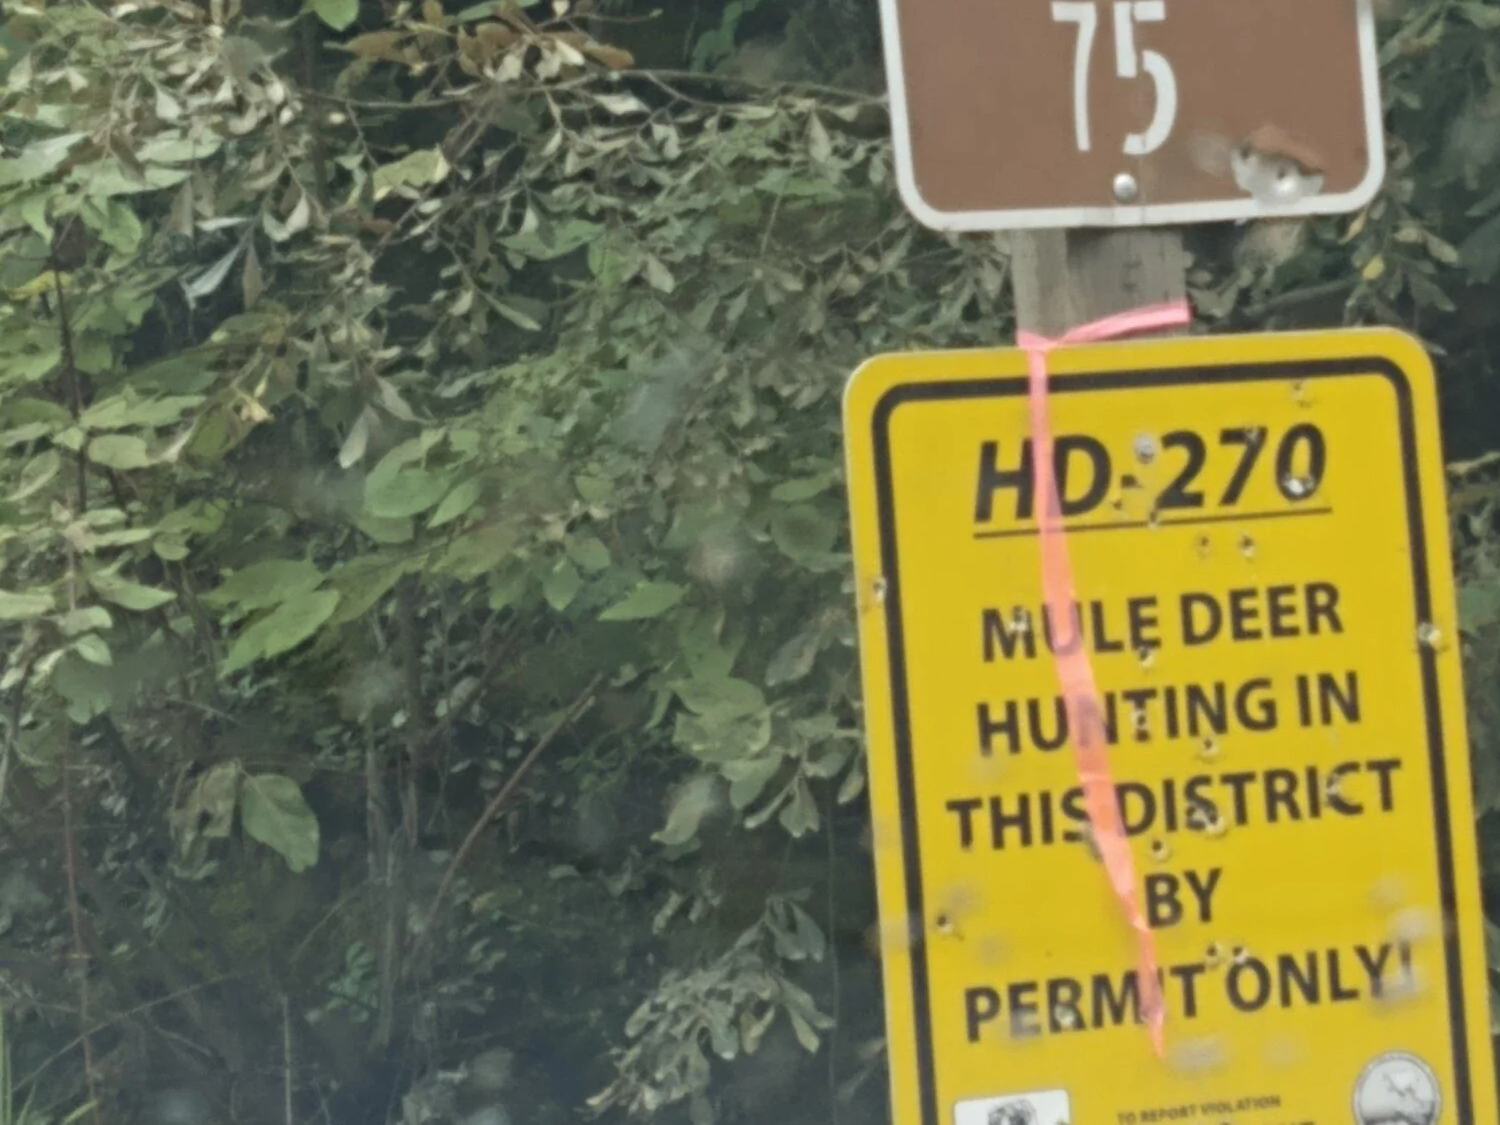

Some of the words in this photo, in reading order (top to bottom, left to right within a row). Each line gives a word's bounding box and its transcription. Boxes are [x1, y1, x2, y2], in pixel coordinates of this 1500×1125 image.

[1051, 0, 1177, 155] 75
[1156, 422, 1327, 512] 270
[981, 595, 1161, 663] MULE
[1179, 581, 1343, 647] DEER
[976, 677, 1278, 757] HUNTING
[1296, 670, 1361, 727] IN
[946, 785, 1093, 850] THIS
[1112, 758, 1402, 837] DISTRICT
[1144, 867, 1222, 929] BY
[964, 962, 1206, 1043] PERMIT
[1117, 1112, 1136, 1124] TO
[1140, 1104, 1197, 1123] REPORT
[1200, 1095, 1281, 1115] VIOLATION
